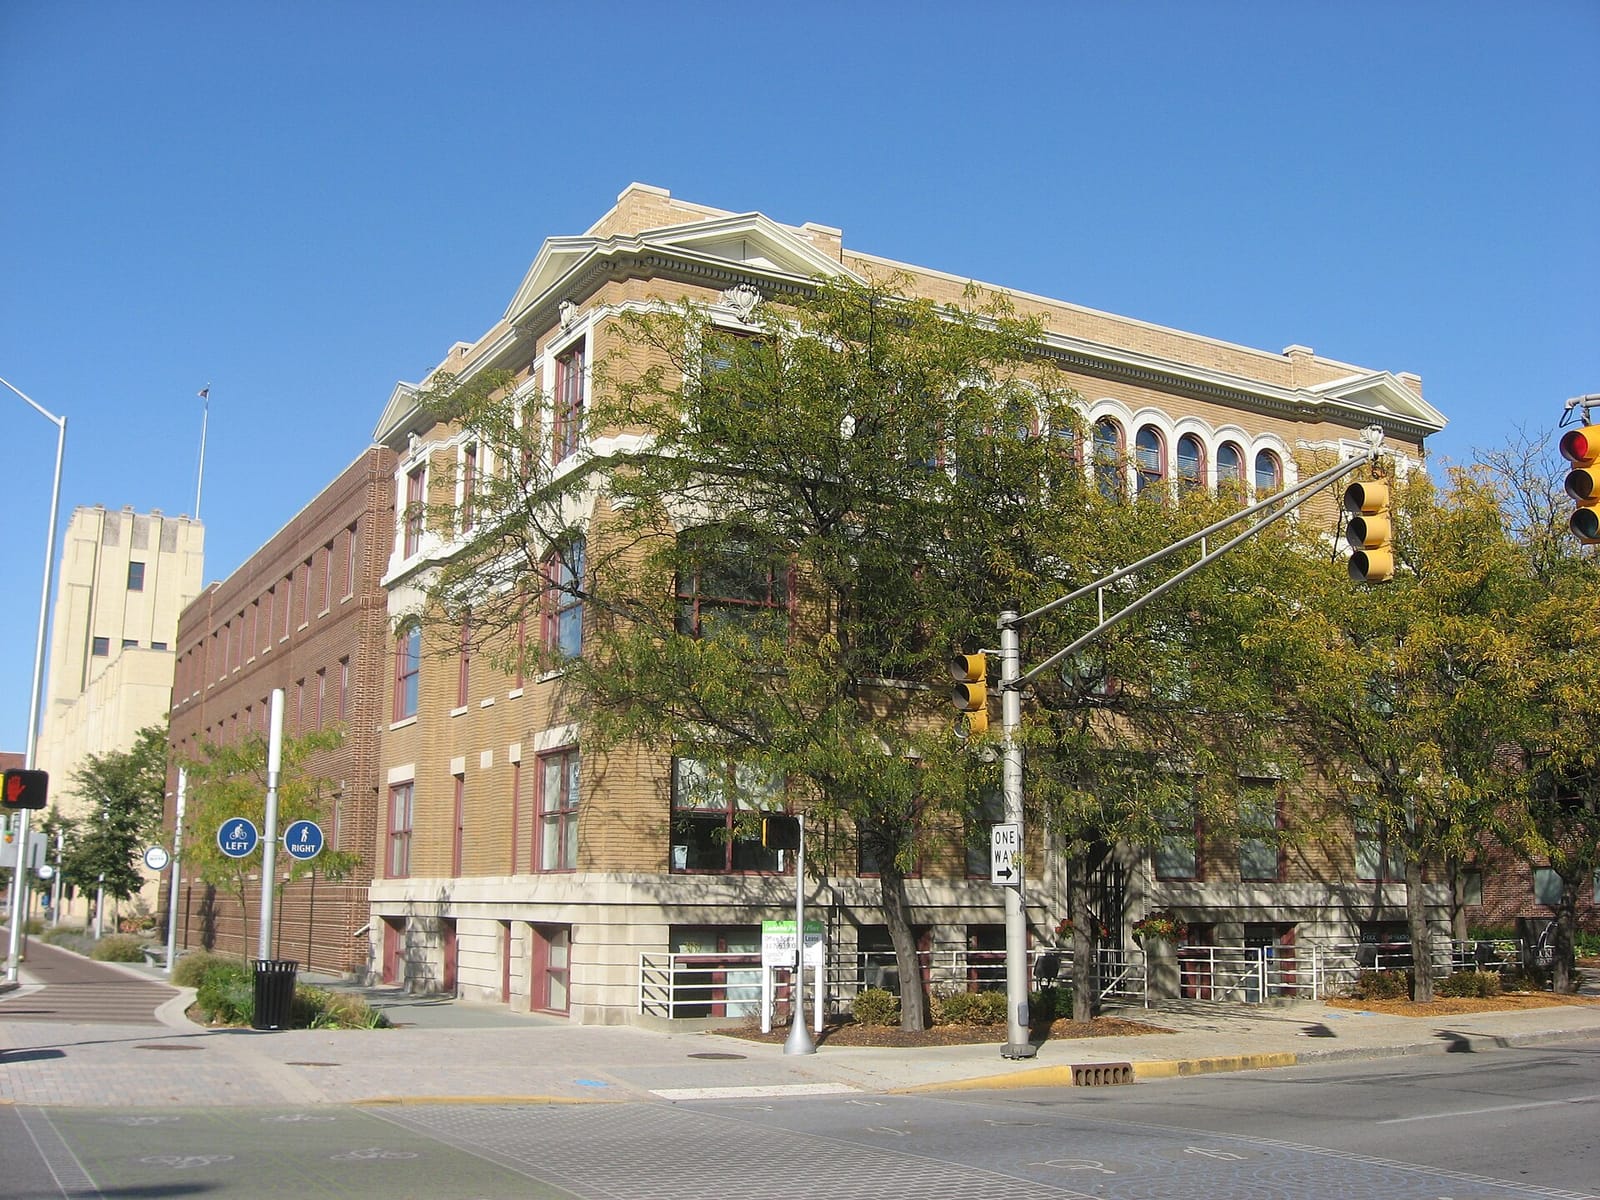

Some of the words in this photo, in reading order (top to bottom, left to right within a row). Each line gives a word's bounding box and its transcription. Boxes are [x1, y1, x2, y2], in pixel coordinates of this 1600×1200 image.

[995, 831, 1015, 845] ONE
[225, 841, 249, 851] LEFT
[291, 844, 316, 853] RIGHT
[995, 850, 1016, 864] WAY
